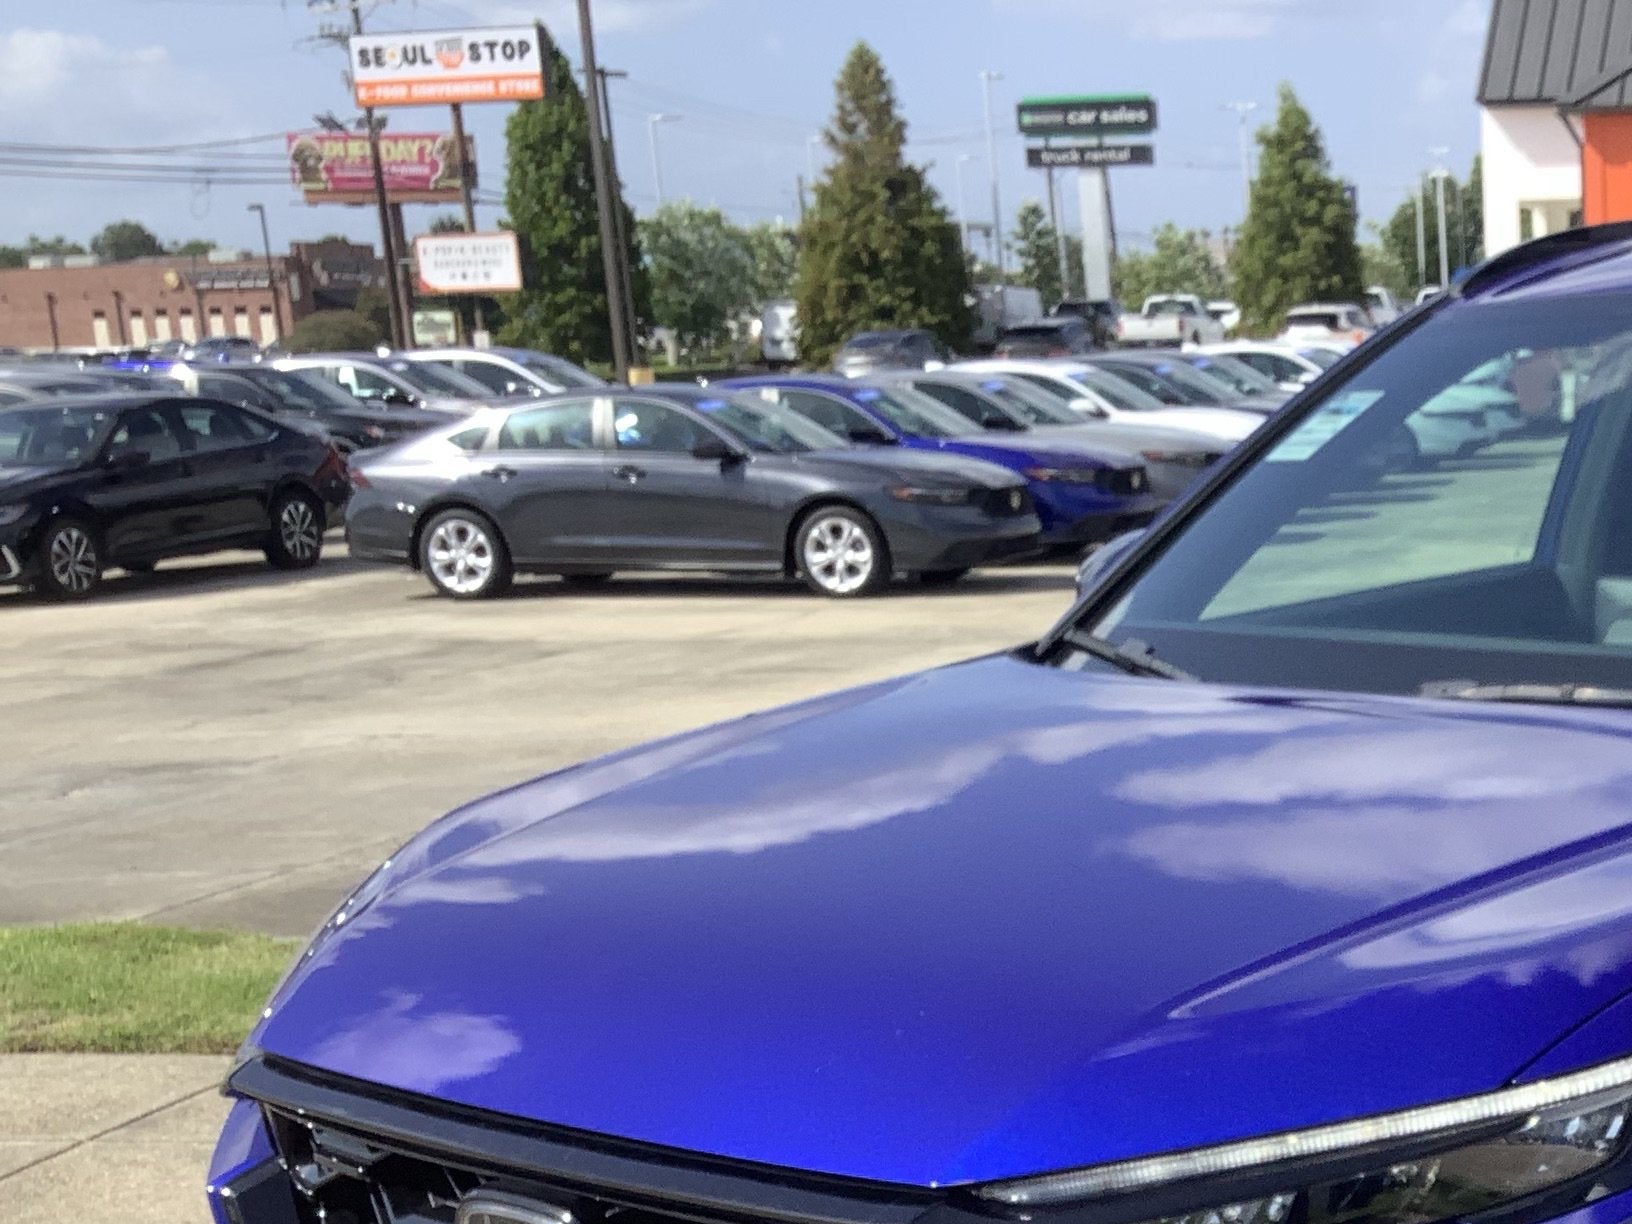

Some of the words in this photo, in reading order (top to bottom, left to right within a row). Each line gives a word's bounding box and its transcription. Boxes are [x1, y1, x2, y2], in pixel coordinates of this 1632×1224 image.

[358, 45, 433, 69] SEOUL
[467, 39, 531, 62] STOP
[1066, 109, 1098, 126] car
[1100, 105, 1148, 123] sales
[1041, 148, 1080, 163] truck
[1083, 146, 1131, 162] rental
